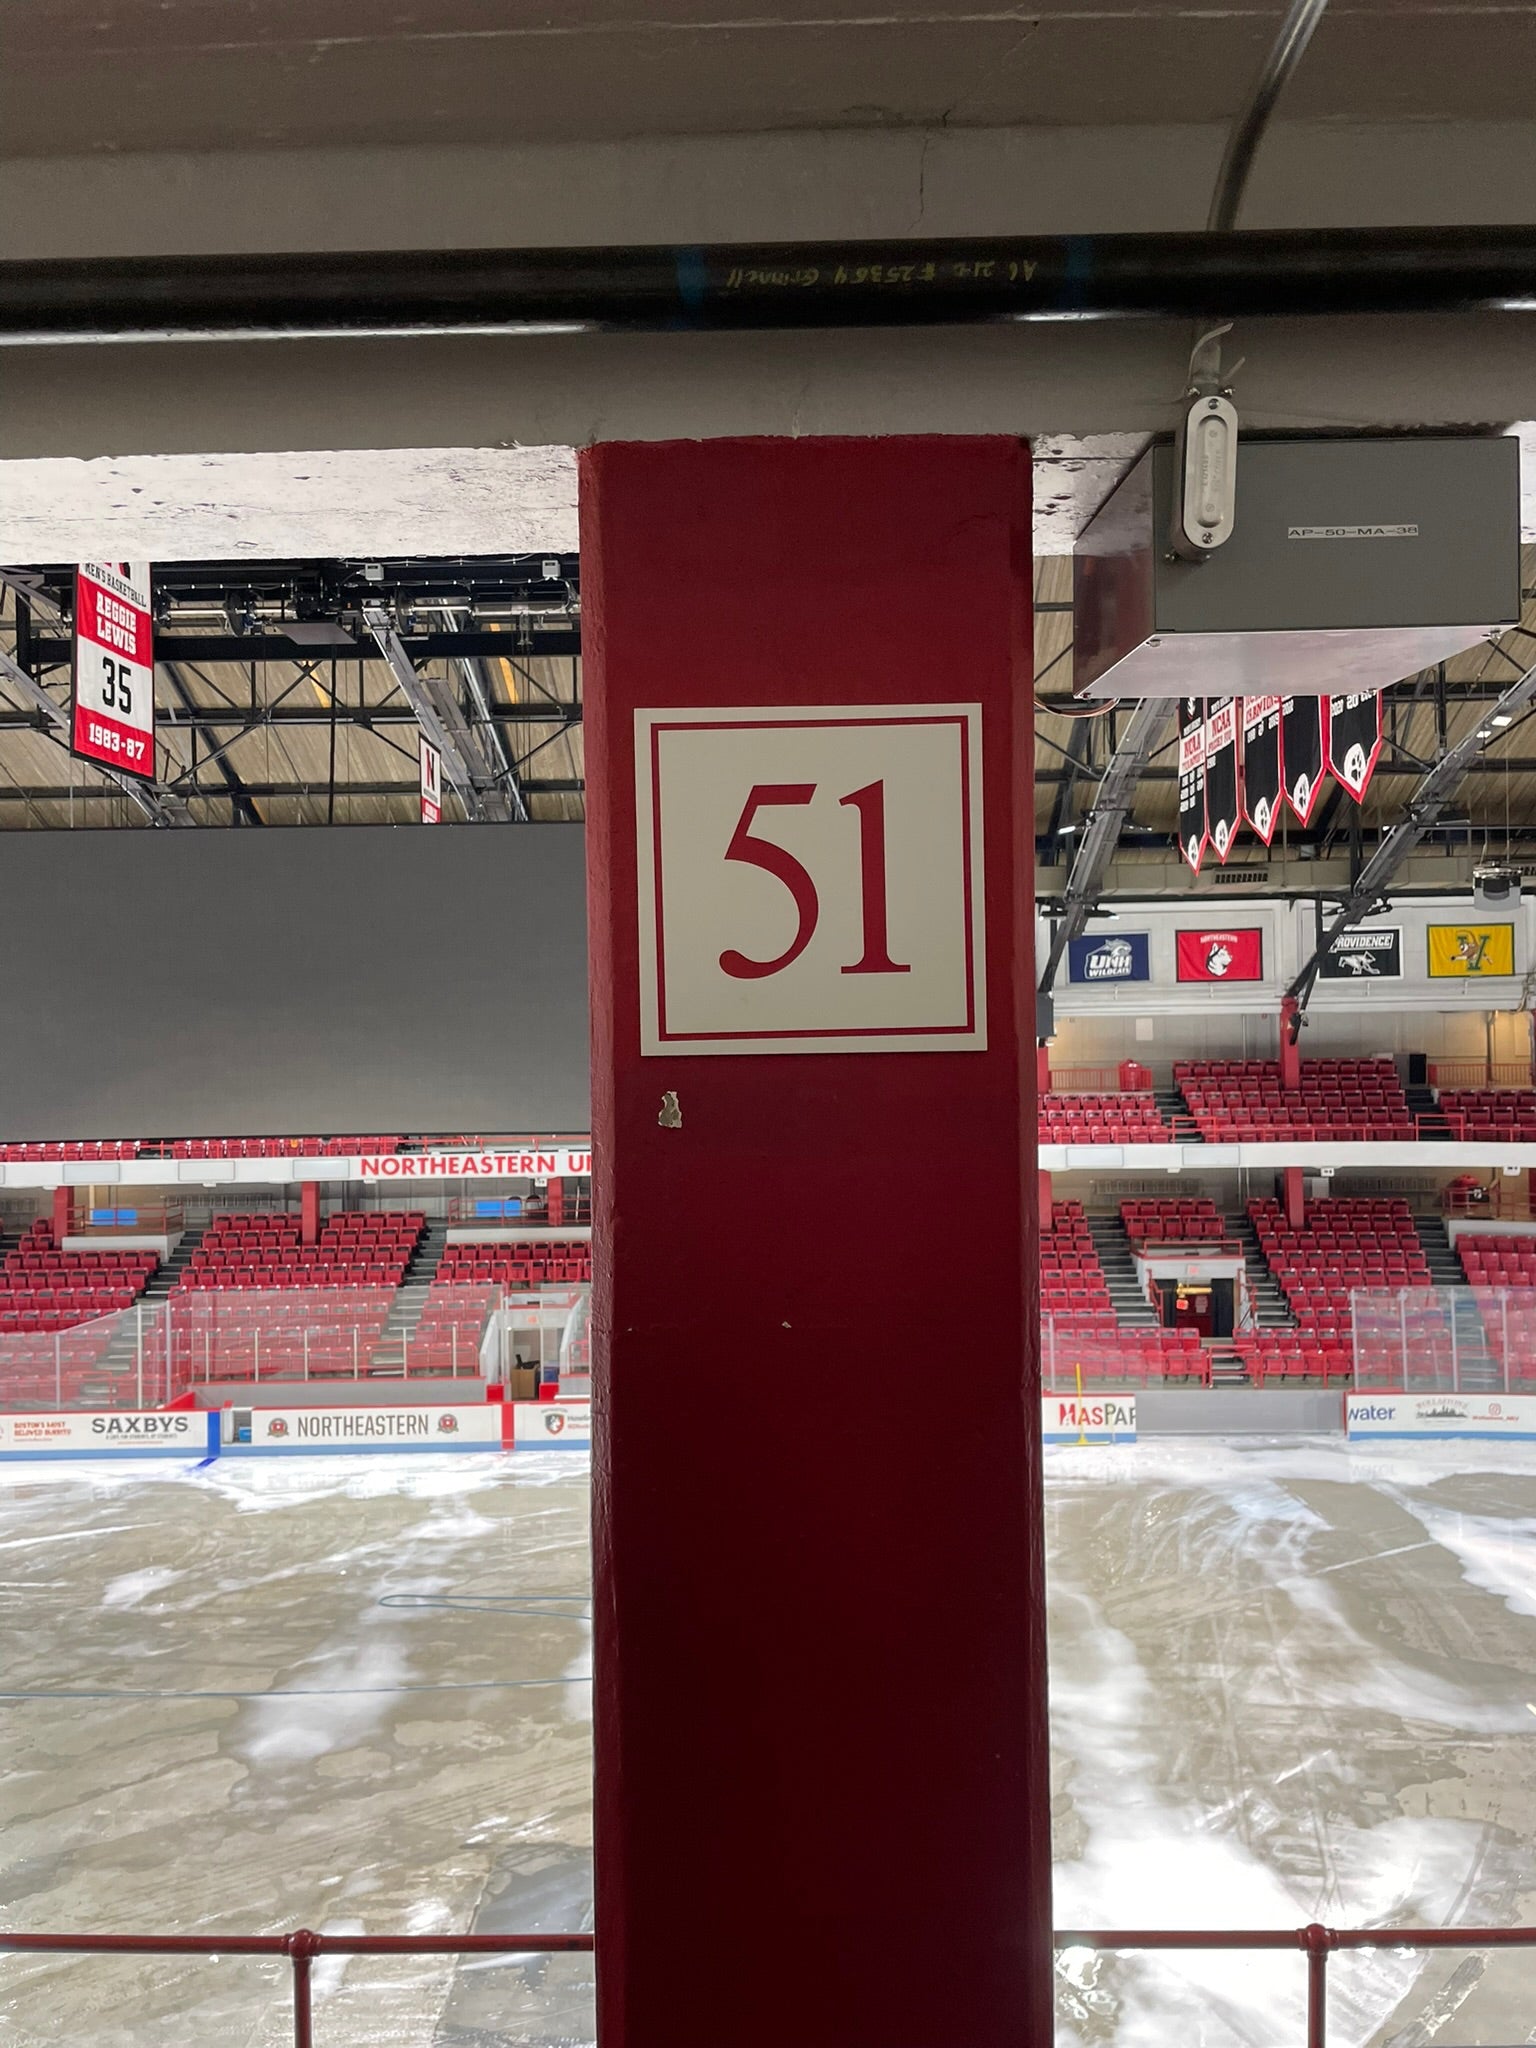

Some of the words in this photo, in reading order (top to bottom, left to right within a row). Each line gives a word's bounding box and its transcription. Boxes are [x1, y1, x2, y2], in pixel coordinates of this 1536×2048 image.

[1288, 526, 1418, 537] AP-50-MA-38
[96, 591, 136, 634] REGGIE
[97, 615, 136, 655] LEWIS
[102, 656, 131, 715] 35
[88, 722, 145, 760] 1983-87
[719, 779, 911, 979] 51
[1200, 934, 1238, 944] NORTHEASTERN
[1089, 968, 1130, 977] WILDCATS
[1090, 955, 1130, 969] UNH
[360, 1155, 555, 1176] NORTHEASTERN
[91, 1416, 189, 1434] SAXBYS
[297, 1414, 429, 1437] NORTHEASTERN
